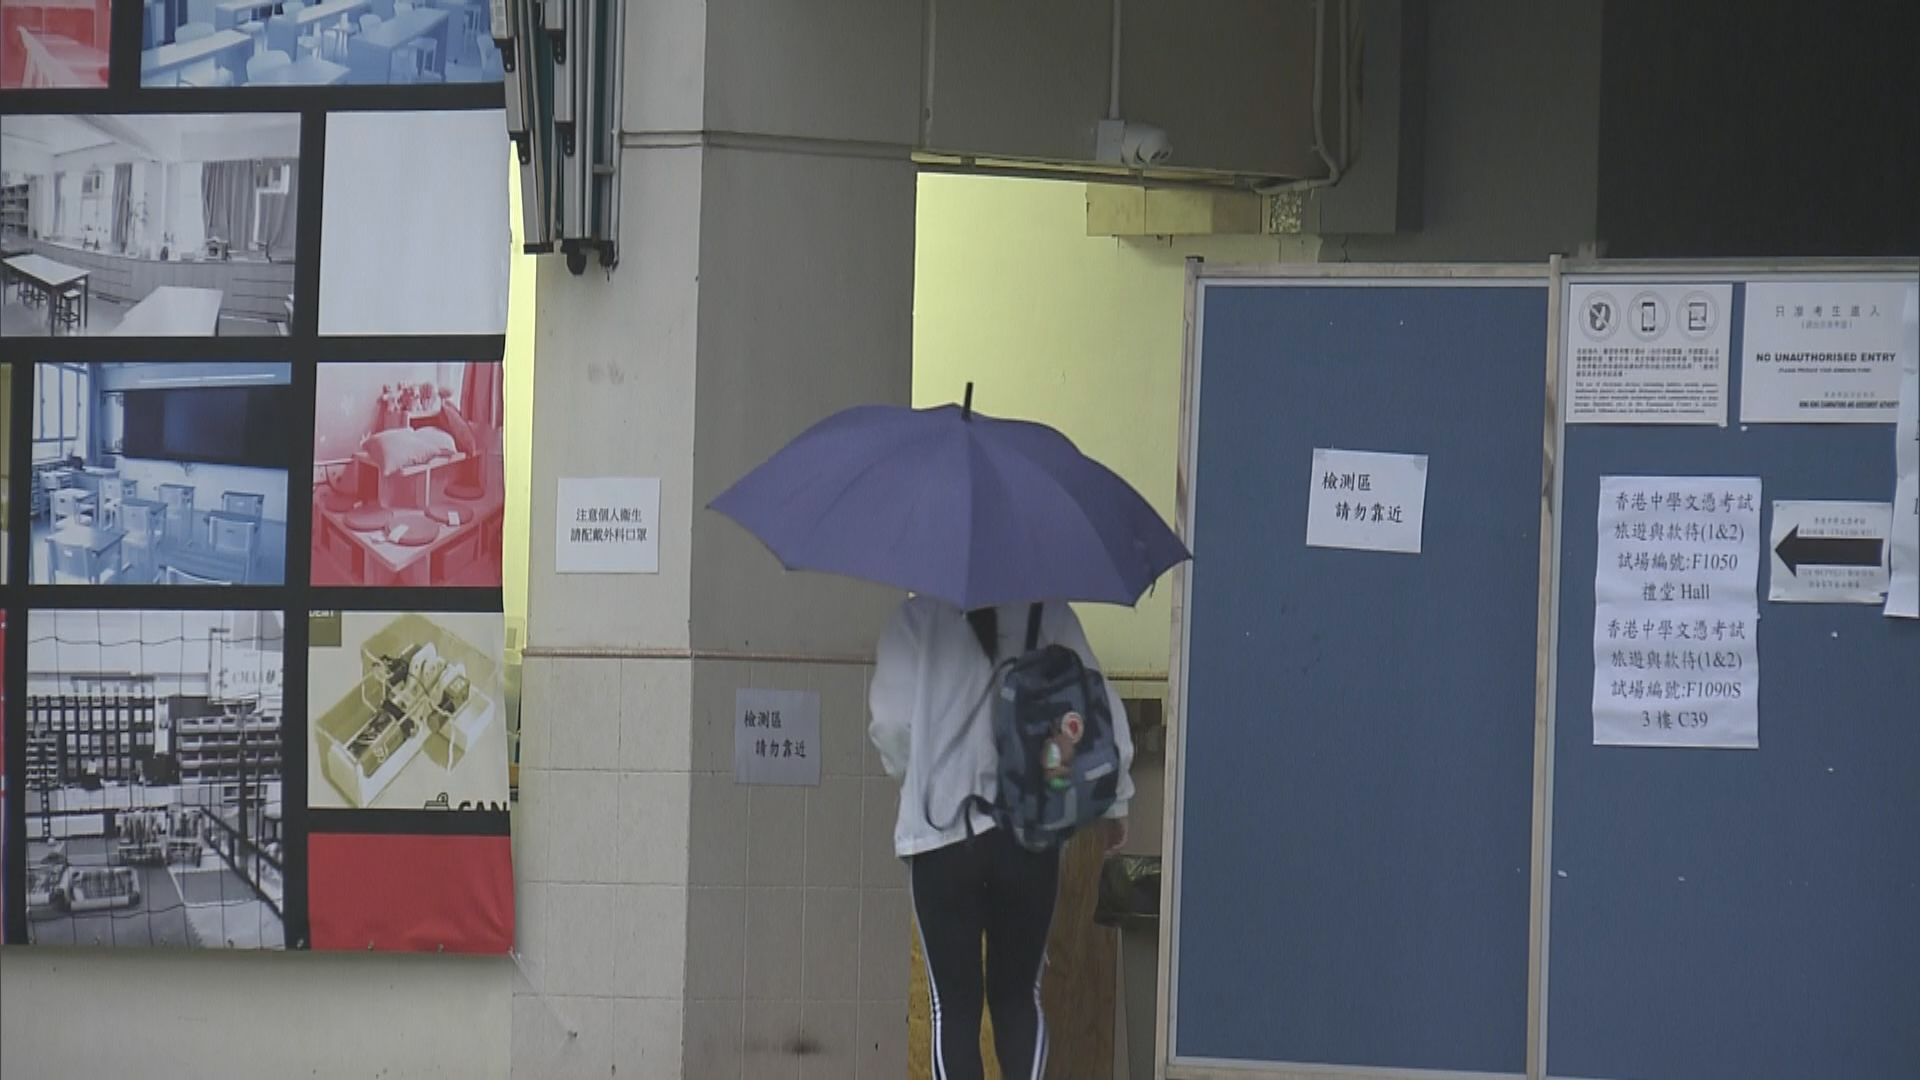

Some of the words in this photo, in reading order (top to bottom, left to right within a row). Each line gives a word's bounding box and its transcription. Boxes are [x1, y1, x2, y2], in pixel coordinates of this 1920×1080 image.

[1756, 352, 1772, 362] NO
[1774, 352, 1858, 363] UNAUTHORISED
[1860, 352, 1897, 363] ENTRY
[1322, 471, 1371, 492] 檢測區
[1335, 501, 1403, 524] 請勿靠近
[1616, 491, 1754, 513] 香港中學文憑考試
[1642, 582, 1676, 602] 禮堂
[1680, 583, 1710, 600] Hall
[1607, 618, 1745, 641] 香港中學文憑考試
[743, 710, 782, 729] 檢測區
[1642, 710, 1651, 728] 3
[1656, 710, 1674, 730] 樓
[1677, 711, 1709, 728] C39
[755, 738, 807, 759] 請勿靠近
